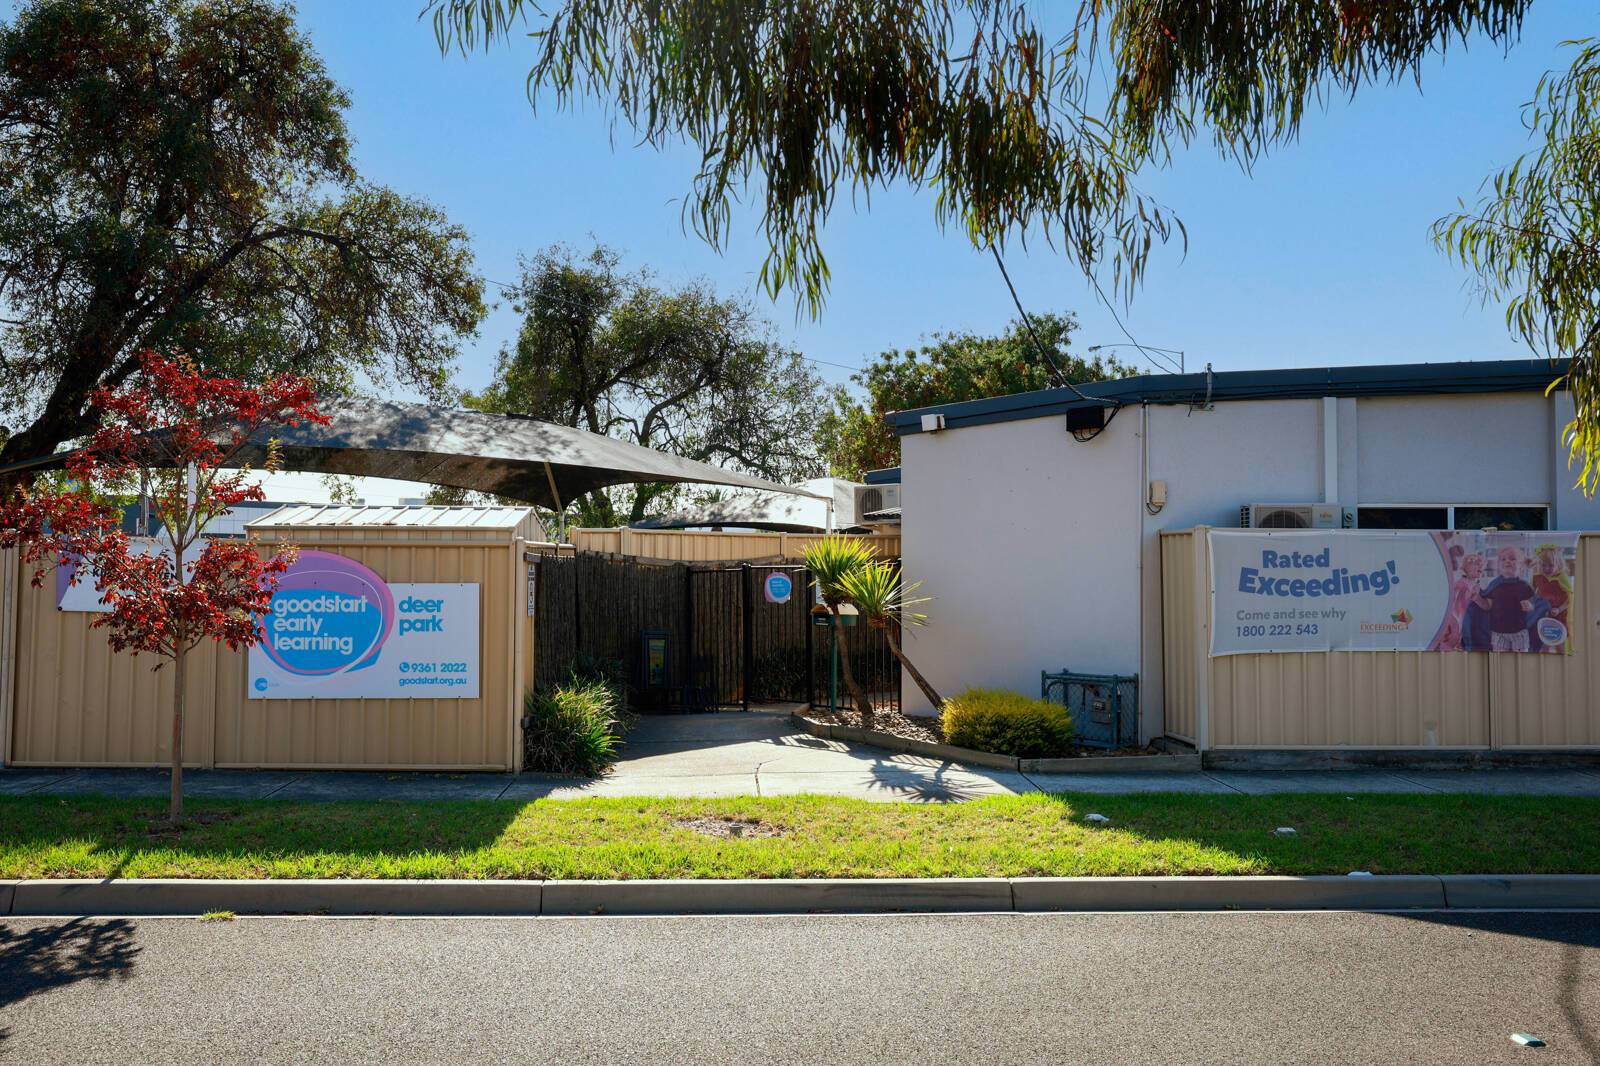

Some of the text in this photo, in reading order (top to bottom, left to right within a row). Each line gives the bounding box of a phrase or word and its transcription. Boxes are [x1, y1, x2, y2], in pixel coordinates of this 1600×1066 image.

[1262, 547, 1330, 569] Rated
[1238, 560, 1400, 598] Exceeding!
[273, 595, 368, 618] goodstart
[398, 595, 444, 613] deer
[1236, 607, 1346, 621] Come and see why
[273, 614, 323, 636] early
[399, 614, 444, 636] park
[1236, 623, 1319, 637] 1800 222 543
[273, 632, 354, 655] learning
[411, 662, 468, 673] 9361 2022
[398, 676, 468, 687] goodstart.org.au
